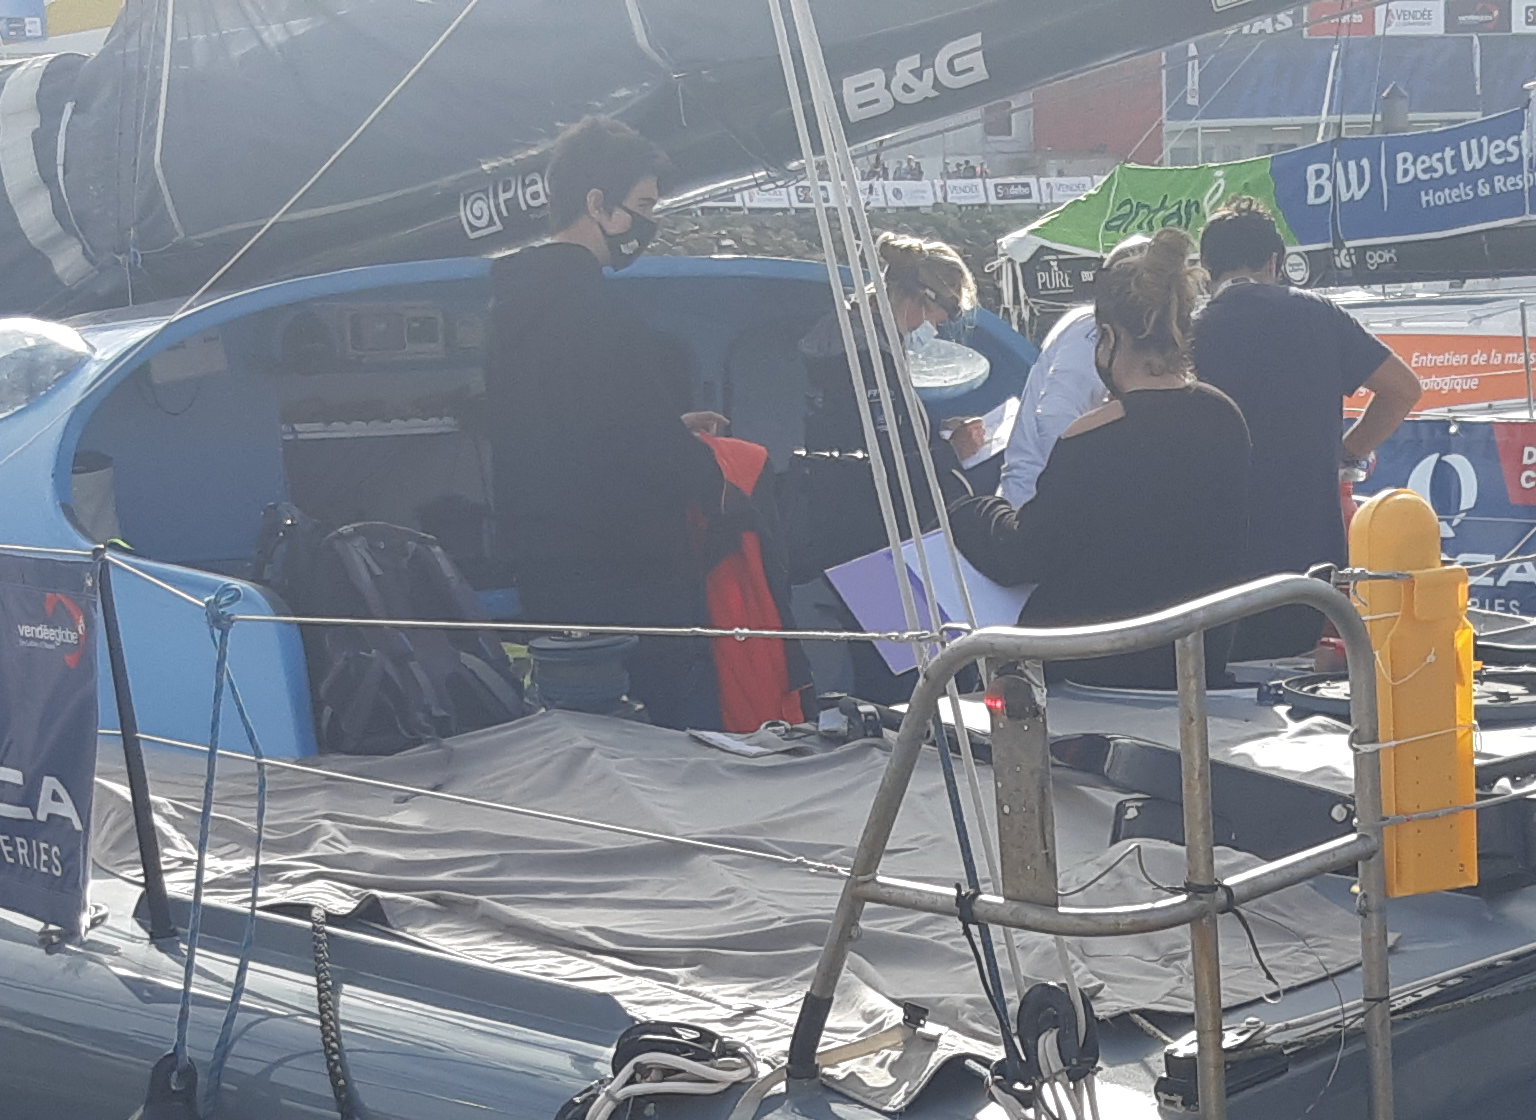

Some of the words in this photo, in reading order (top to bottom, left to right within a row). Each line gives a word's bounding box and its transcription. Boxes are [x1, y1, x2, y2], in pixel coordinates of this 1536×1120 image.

[842, 33, 989, 123] B&G
[1306, 158, 1372, 206] BW
[1395, 146, 1457, 185] Best
[1420, 184, 1474, 209] Hotels
[1477, 178, 1491, 197] &
[1411, 351, 1468, 368] Entretien
[1471, 349, 1487, 366] de
[1489, 348, 1506, 365] la
[1420, 374, 1480, 394] iologique
